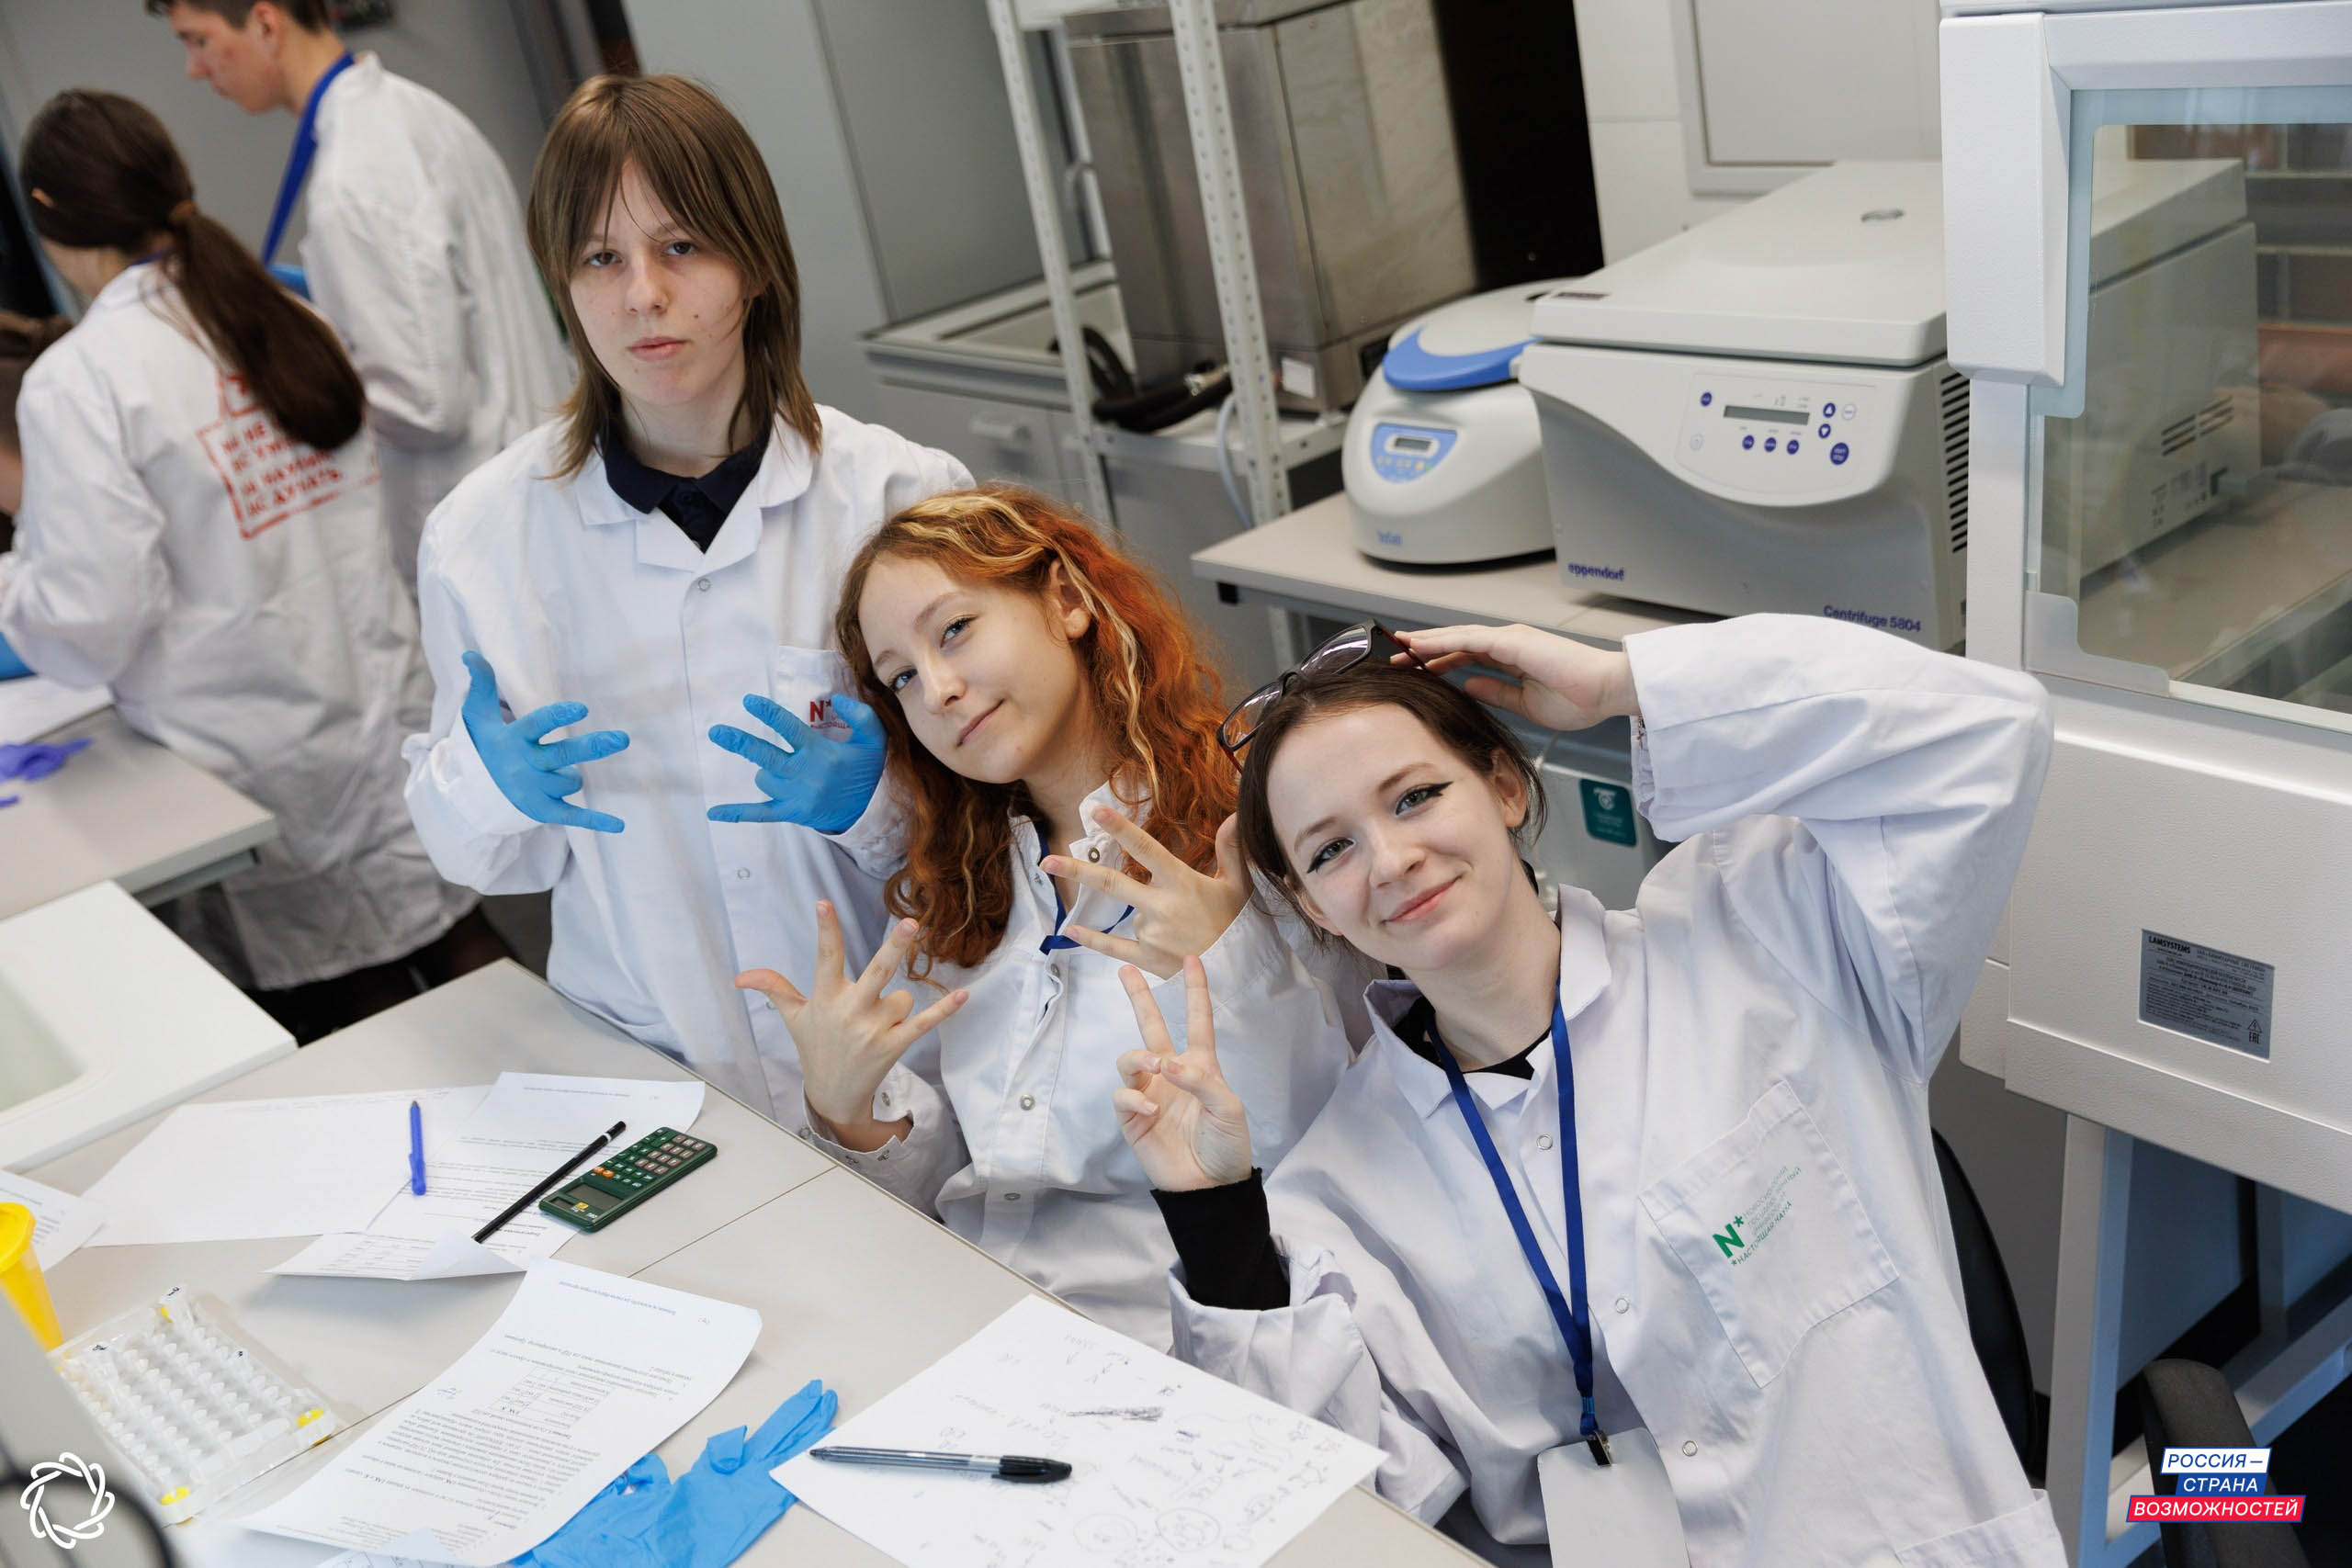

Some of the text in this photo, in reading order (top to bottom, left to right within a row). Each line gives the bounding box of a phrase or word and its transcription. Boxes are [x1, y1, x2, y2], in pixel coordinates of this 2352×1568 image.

[1567, 561, 1625, 581] eppendorf
[1824, 604, 1922, 633] Centrifuge 5804
[2148, 935, 2191, 954] LAMSYSTEMS
